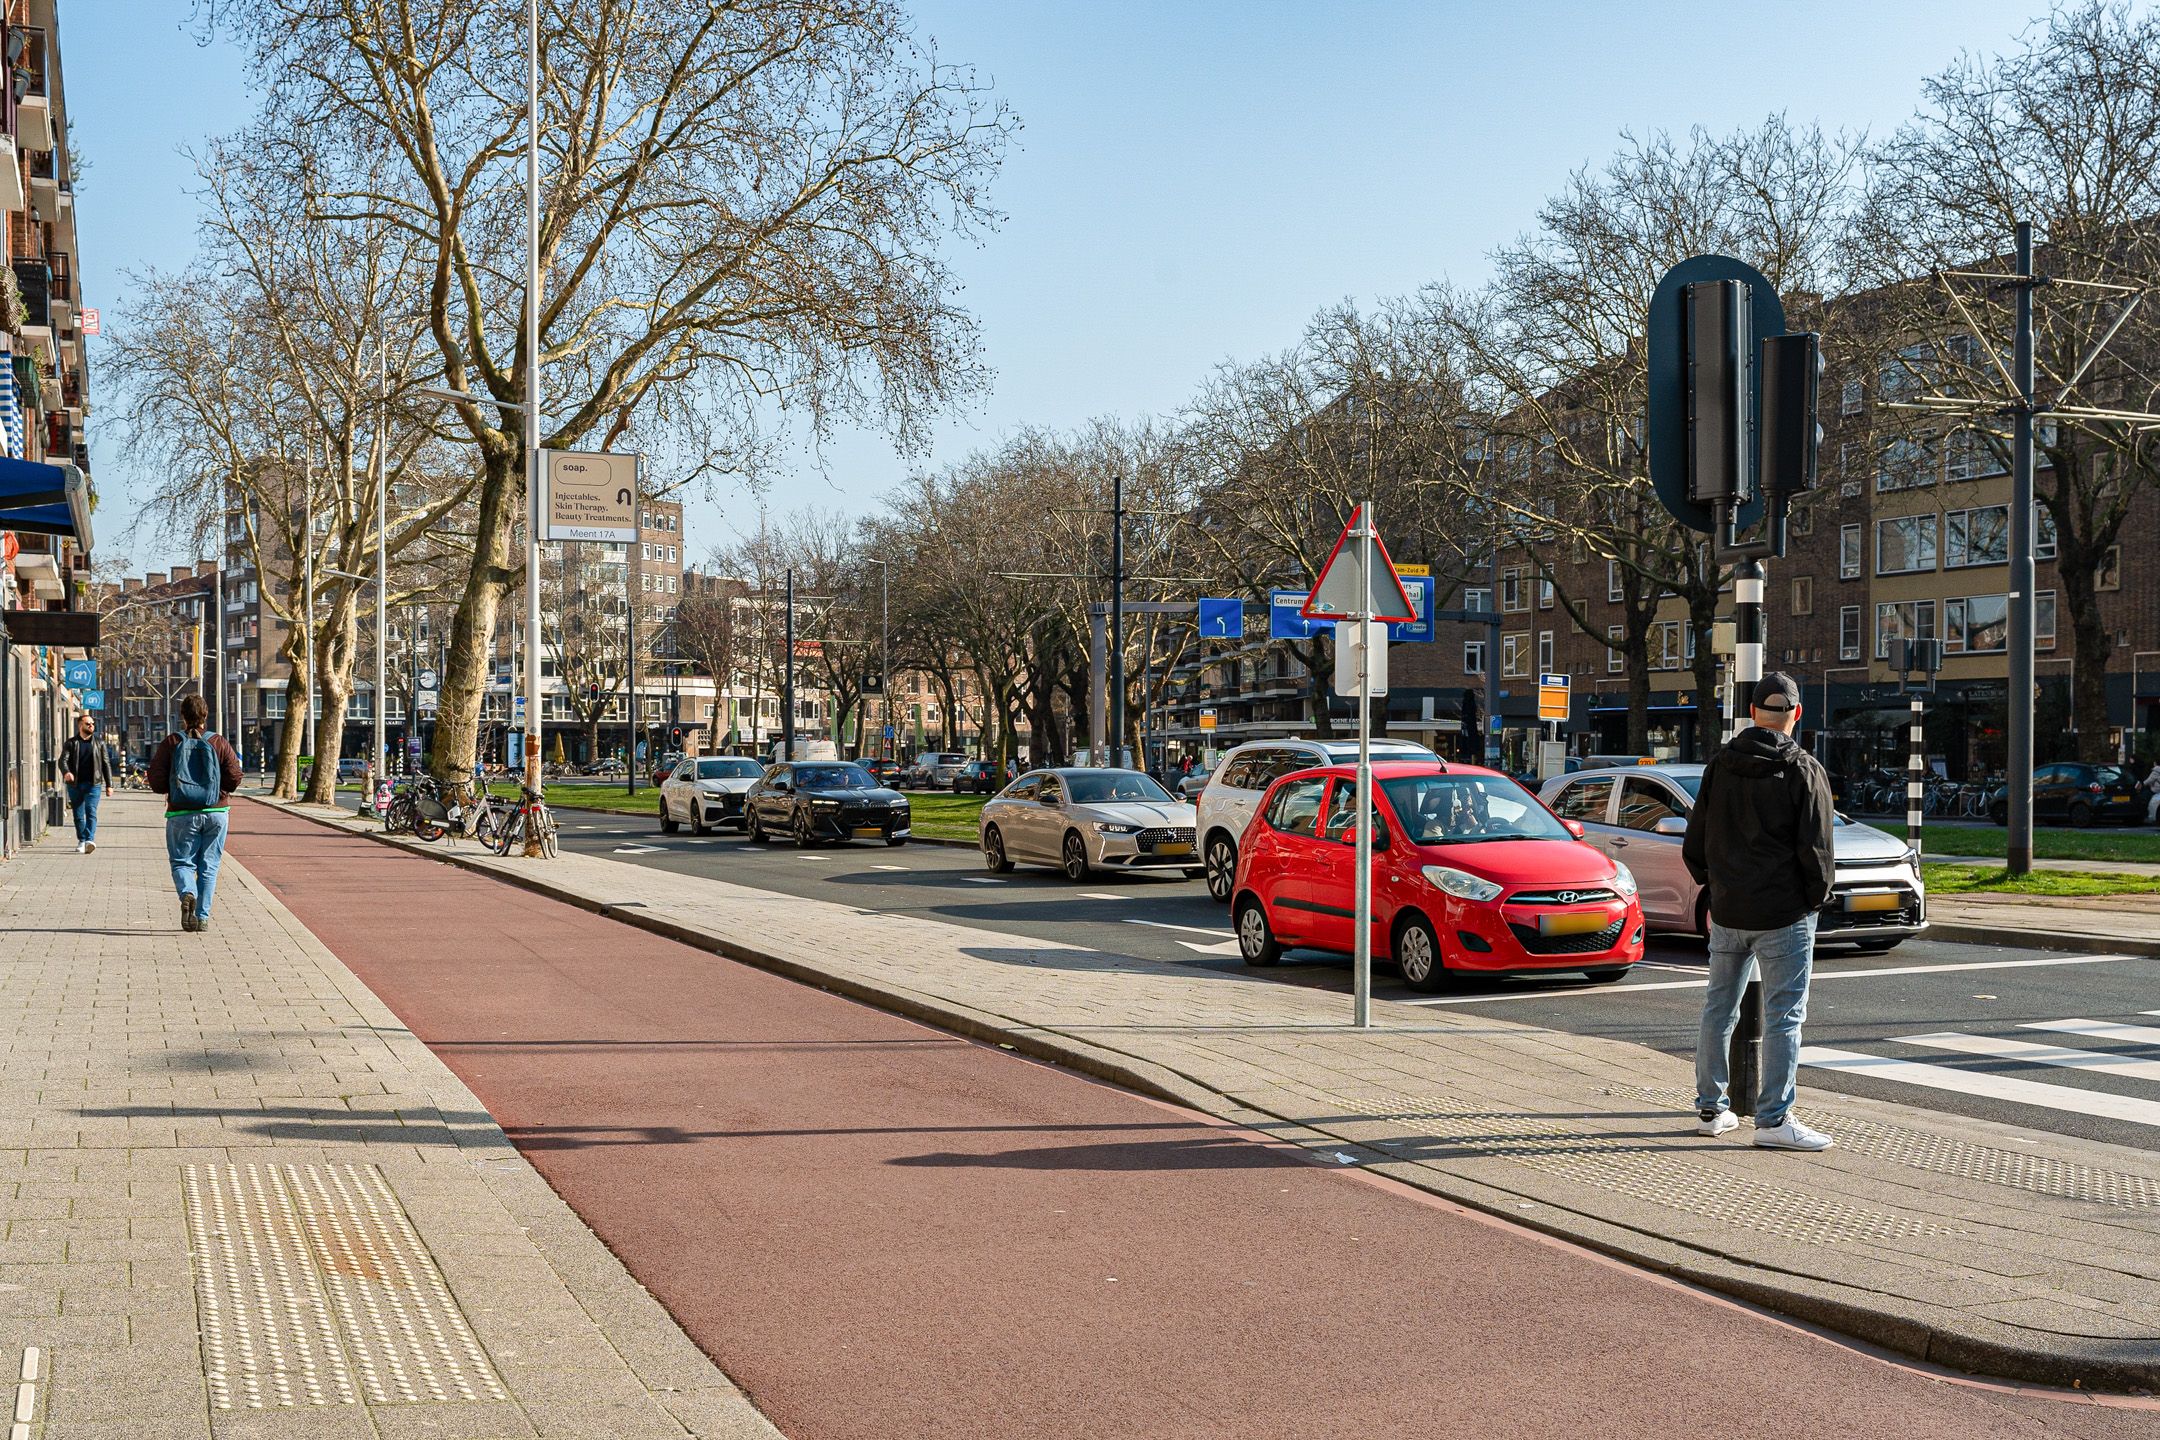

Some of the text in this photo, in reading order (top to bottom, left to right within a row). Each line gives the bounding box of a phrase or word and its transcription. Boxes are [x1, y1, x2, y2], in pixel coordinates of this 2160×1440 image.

[562, 463, 588, 473] soap.
[555, 492, 601, 502] Injectables.
[555, 502, 609, 512] Skin Therapy.
[555, 512, 632, 523] Beauty Treatments.
[569, 528, 616, 539] Meent 17A
